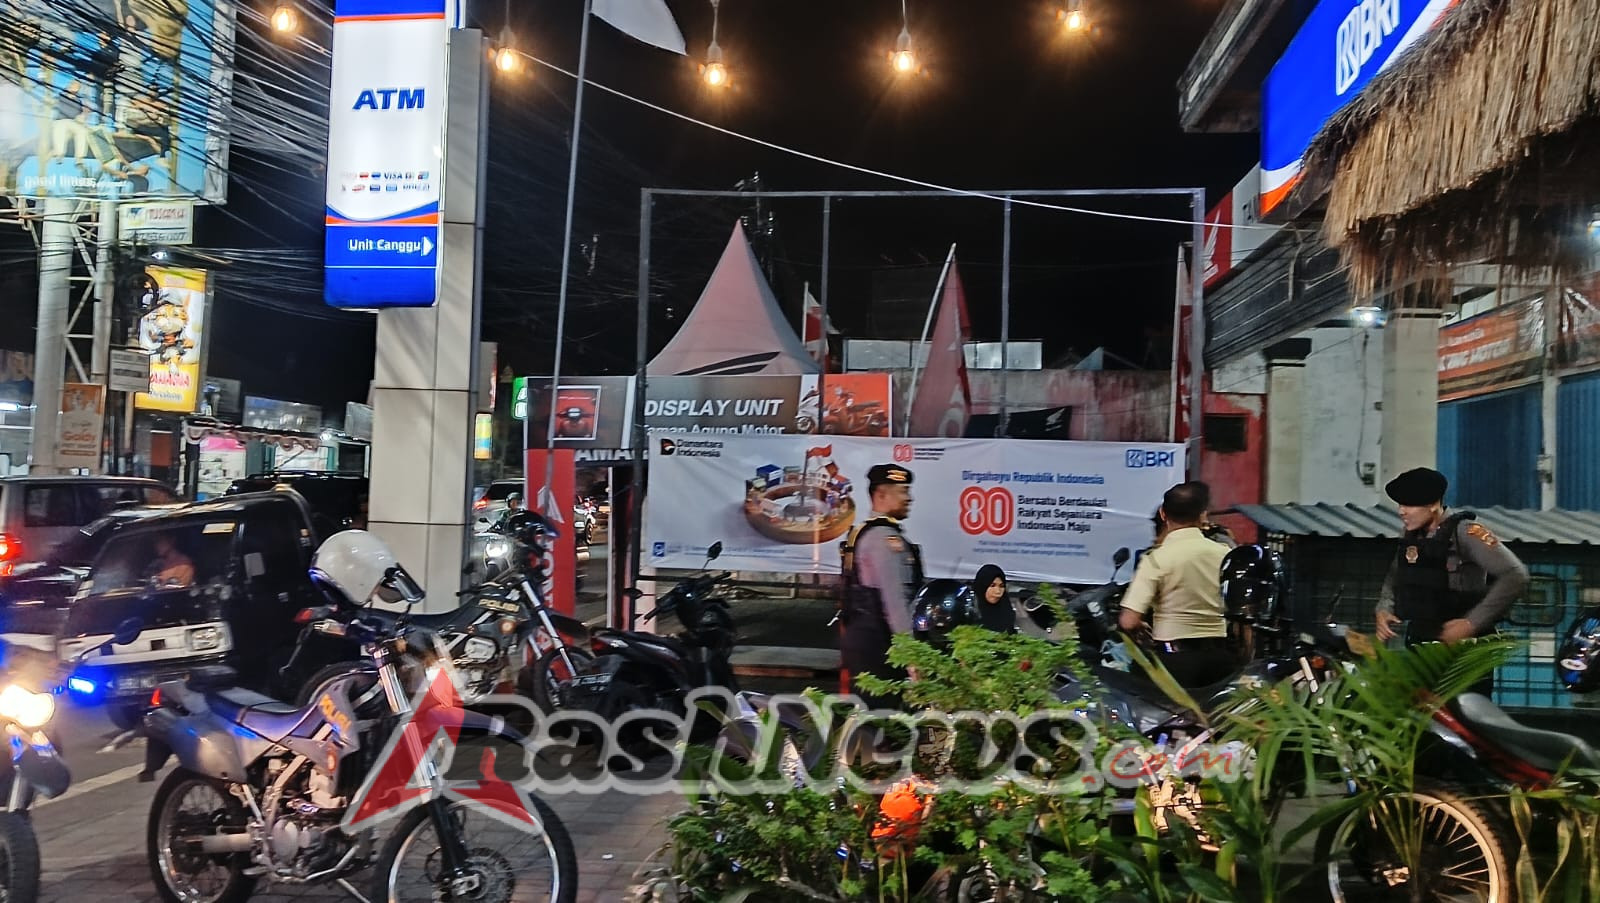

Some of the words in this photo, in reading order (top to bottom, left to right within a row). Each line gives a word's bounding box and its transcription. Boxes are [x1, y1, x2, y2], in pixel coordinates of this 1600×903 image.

[352, 88, 425, 110] ATM
[349, 238, 373, 251] Unit
[376, 239, 422, 254] Canggu
[643, 399, 732, 416] DISPLAY
[734, 399, 785, 416] UNIT
[677, 449, 721, 458] Indonesia
[1145, 451, 1174, 467] BRI
[961, 470, 1011, 483] Dirgahayu
[1012, 472, 1054, 484] Republik
[1056, 473, 1104, 484] Indonesia
[1017, 495, 1056, 506] Bersatu
[1058, 496, 1107, 507] Berdaulat
[959, 486, 1013, 536] 80
[1017, 507, 1052, 519] Rakyat
[1017, 520, 1065, 530] Indonesia
[1067, 522, 1091, 533] Maju
[478, 598, 520, 613] POLISI
